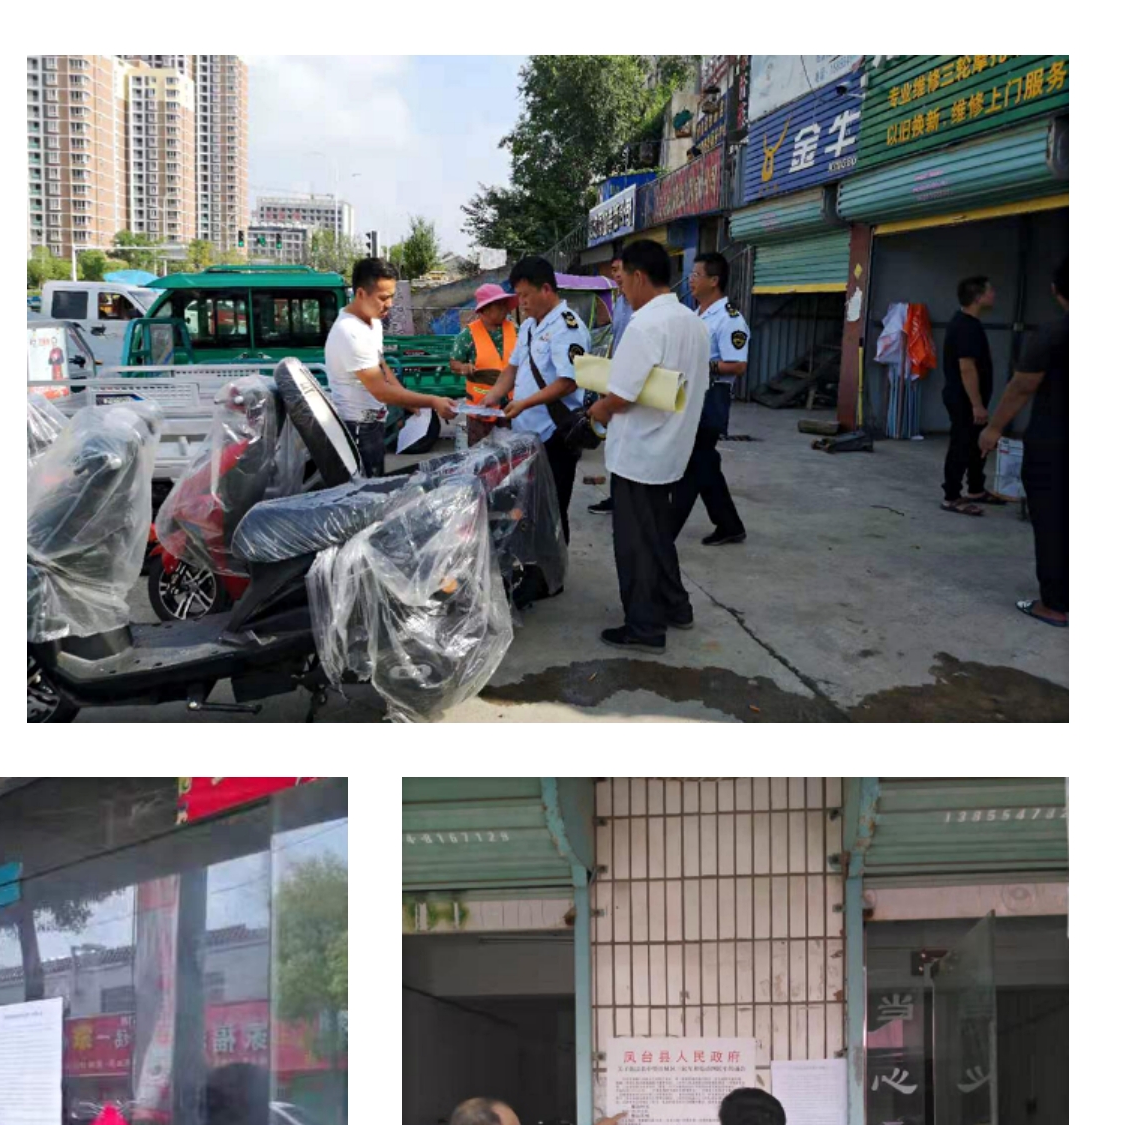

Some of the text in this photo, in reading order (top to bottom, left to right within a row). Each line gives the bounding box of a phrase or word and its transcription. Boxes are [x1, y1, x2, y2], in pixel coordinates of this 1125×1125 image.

[789, 109, 861, 173] 金牛
[623, 1050, 741, 1063] 凤台县人民政府
